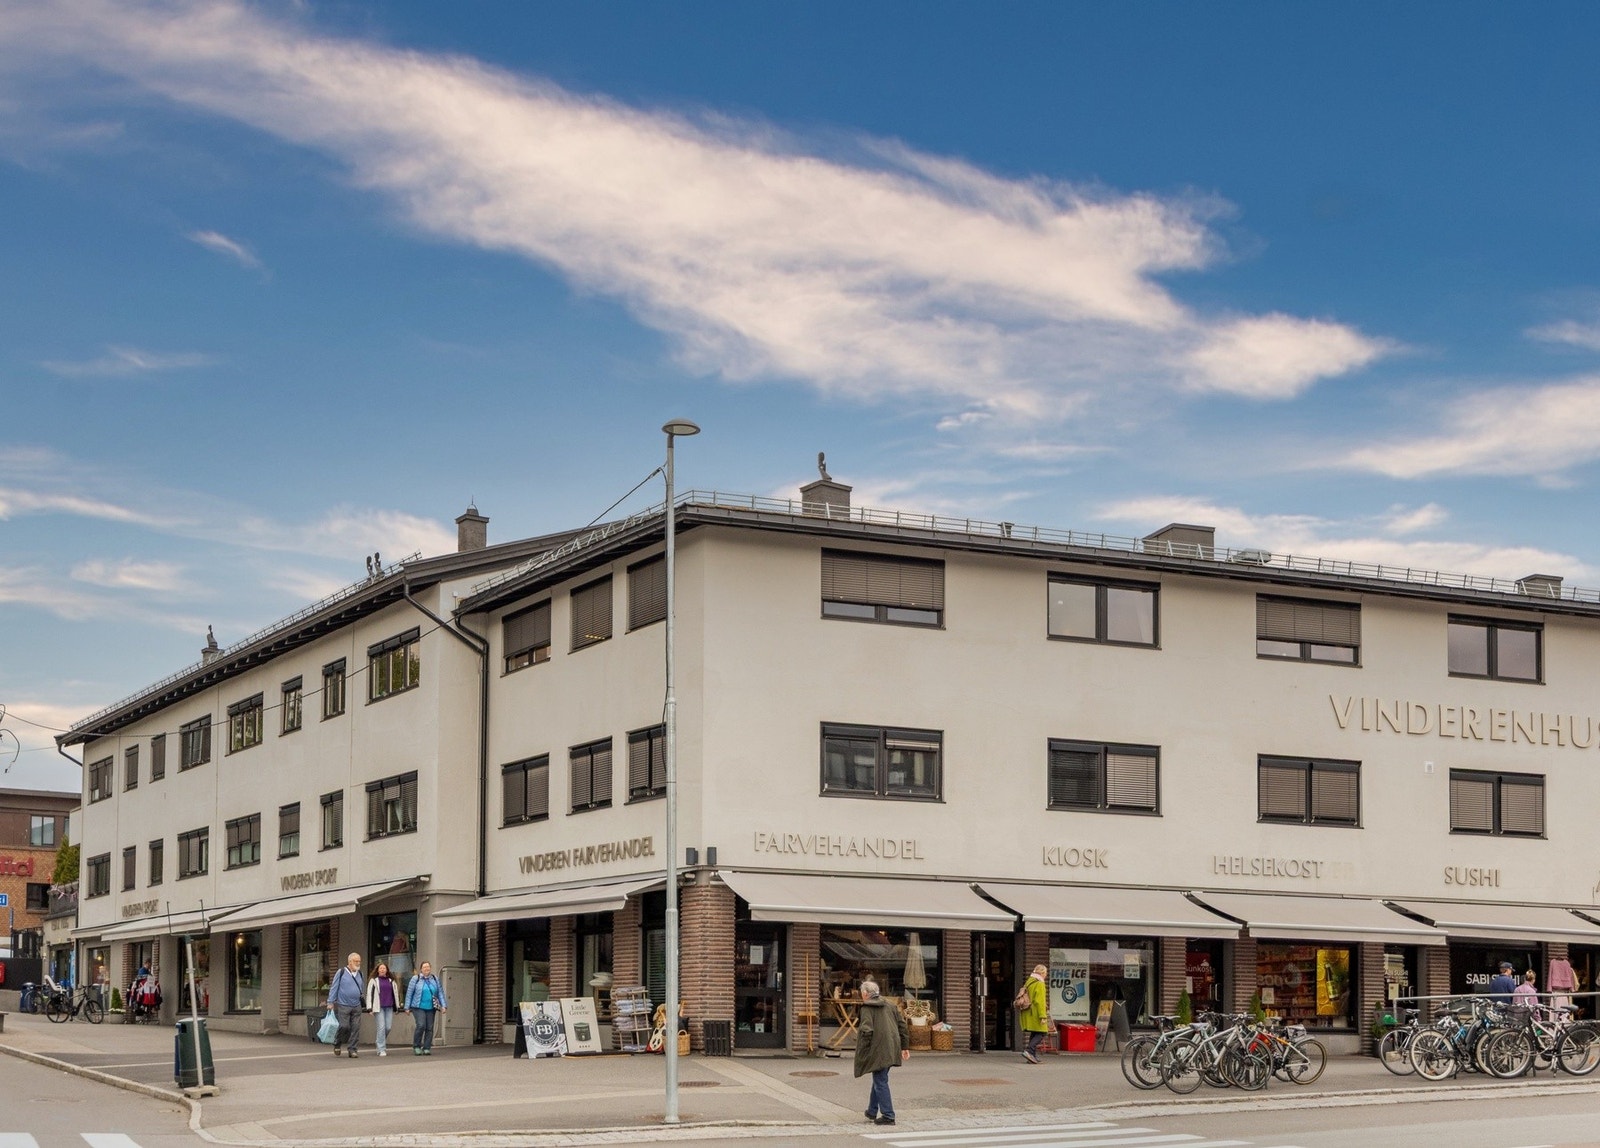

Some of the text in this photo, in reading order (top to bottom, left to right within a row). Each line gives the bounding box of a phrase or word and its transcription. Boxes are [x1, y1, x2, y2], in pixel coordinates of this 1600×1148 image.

[1329, 694, 1600, 748] VINDERENHU
[519, 836, 655, 874] VINDEREN FARVEHANDEL
[754, 831, 925, 860] FARVEHANDEL
[1042, 846, 1109, 868] KIOSK
[1213, 855, 1324, 879] HELSEKOST
[1444, 866, 1500, 887] SUSHI
[1050, 979, 1070, 988] CUP
[1051, 969, 1087, 978] THE ICE
[1466, 973, 1490, 985] SABI
